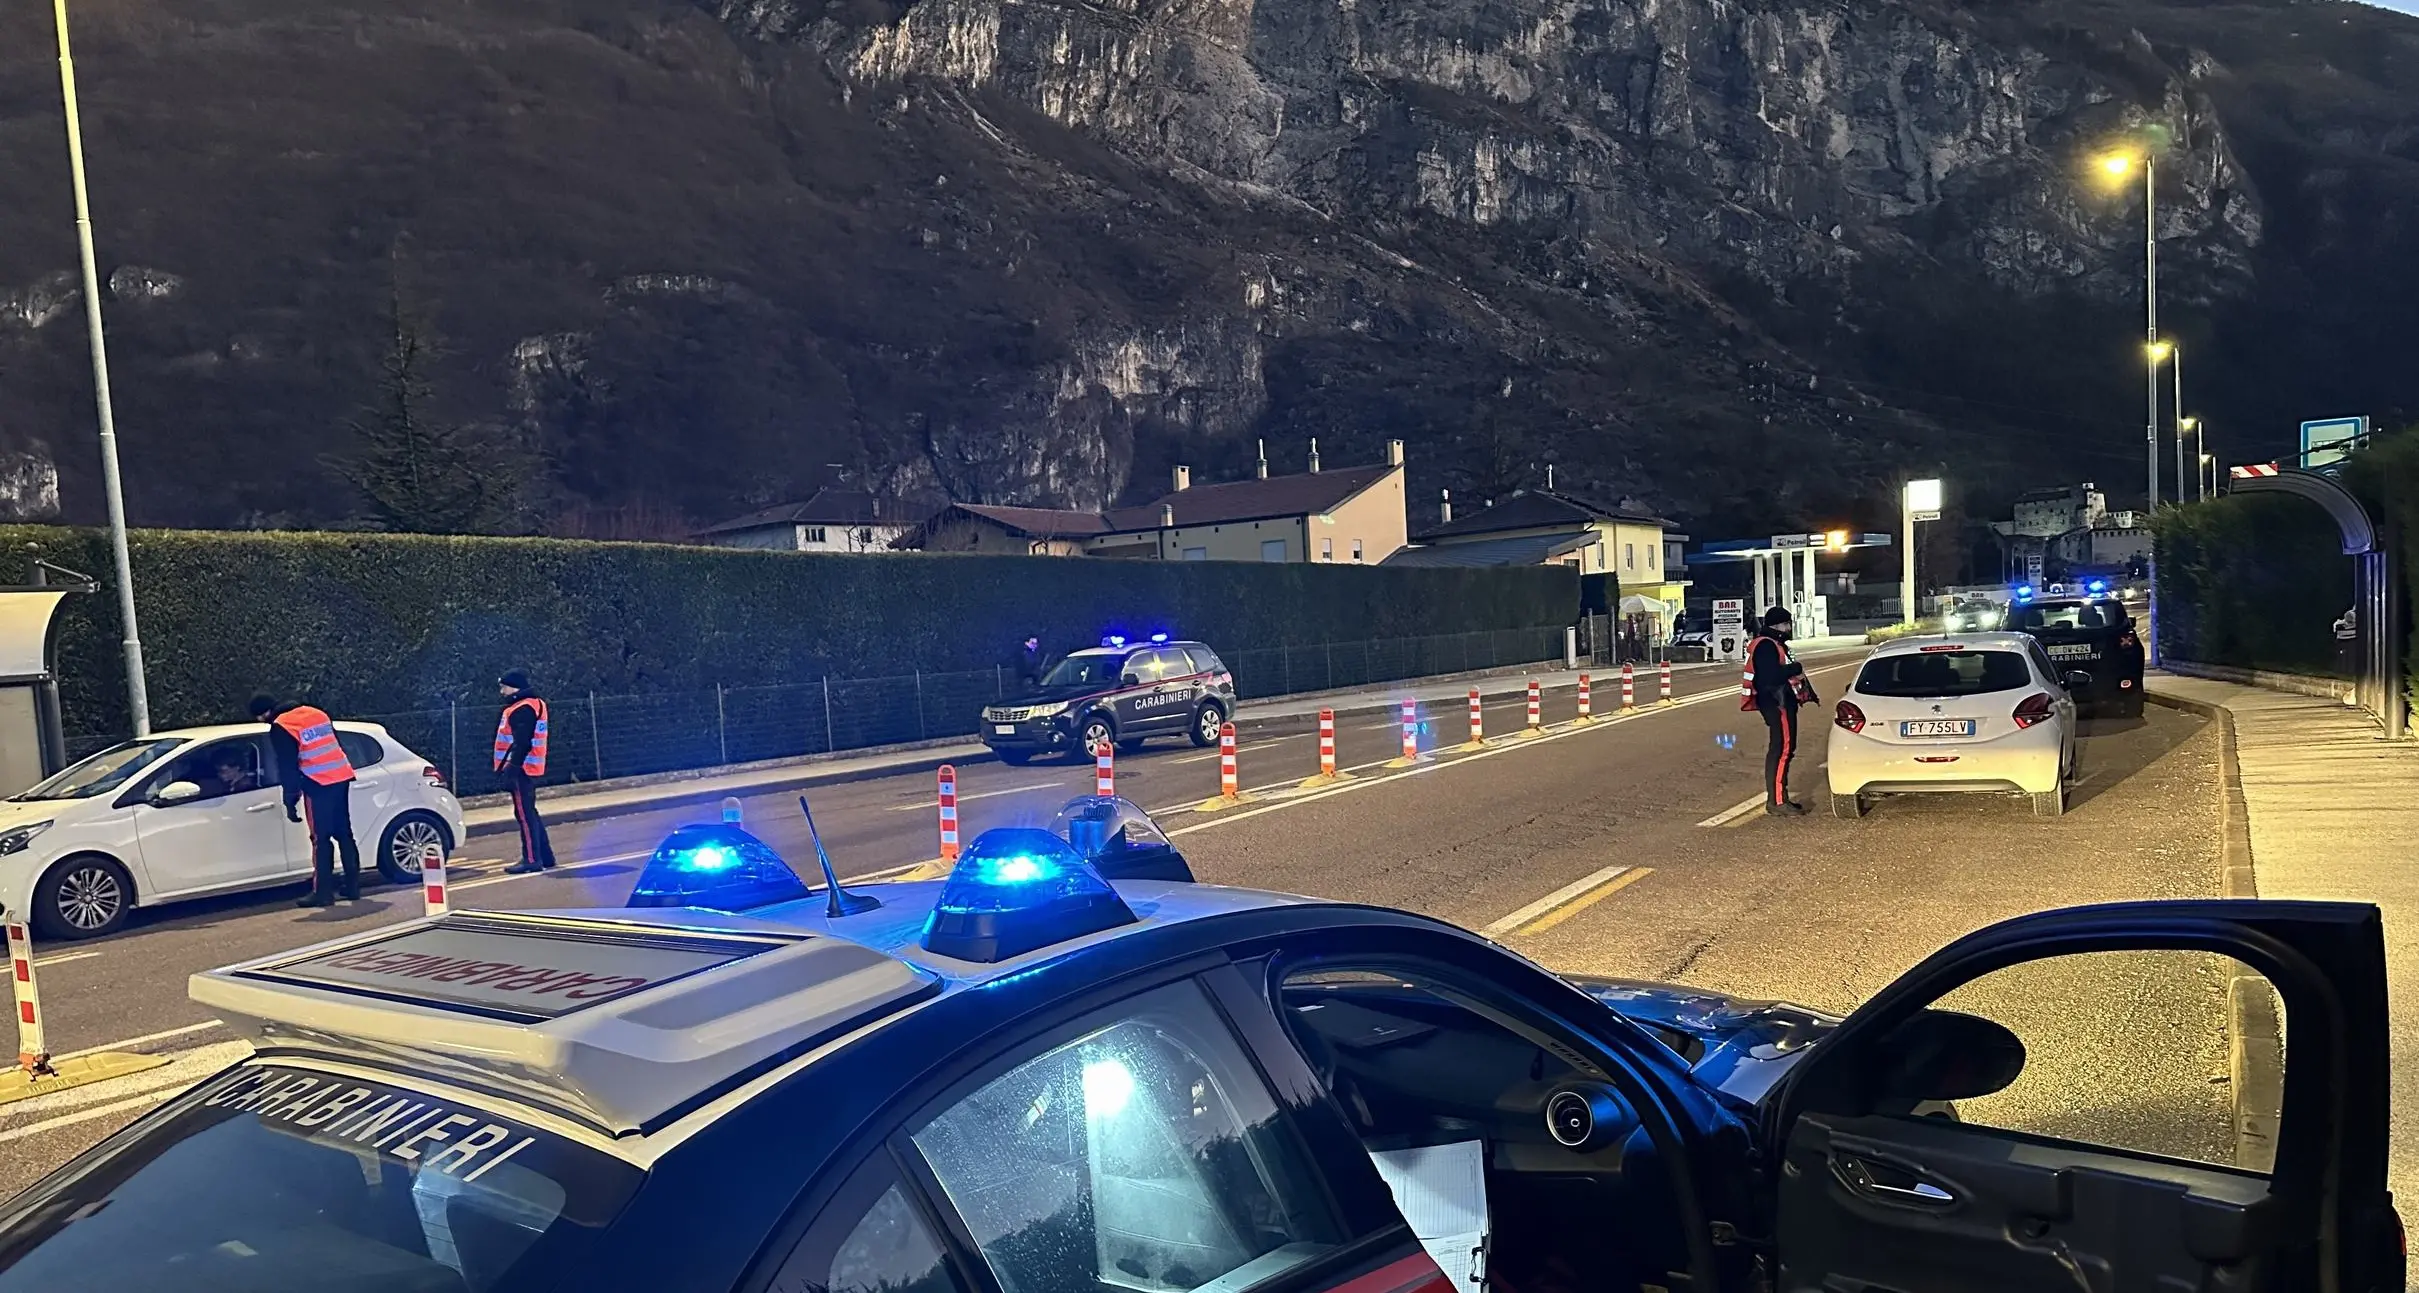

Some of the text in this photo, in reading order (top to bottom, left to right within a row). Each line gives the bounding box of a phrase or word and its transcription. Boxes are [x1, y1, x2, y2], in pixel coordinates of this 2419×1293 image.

[1718, 601, 1737, 609] BAR
[2051, 652, 2102, 661] RABINIERI
[1135, 689, 1192, 711] CARABINIERI
[1909, 720, 1967, 734] FY 755LV
[312, 949, 648, 999] CARABINIERI
[204, 1070, 536, 1182] CARABINIERI
